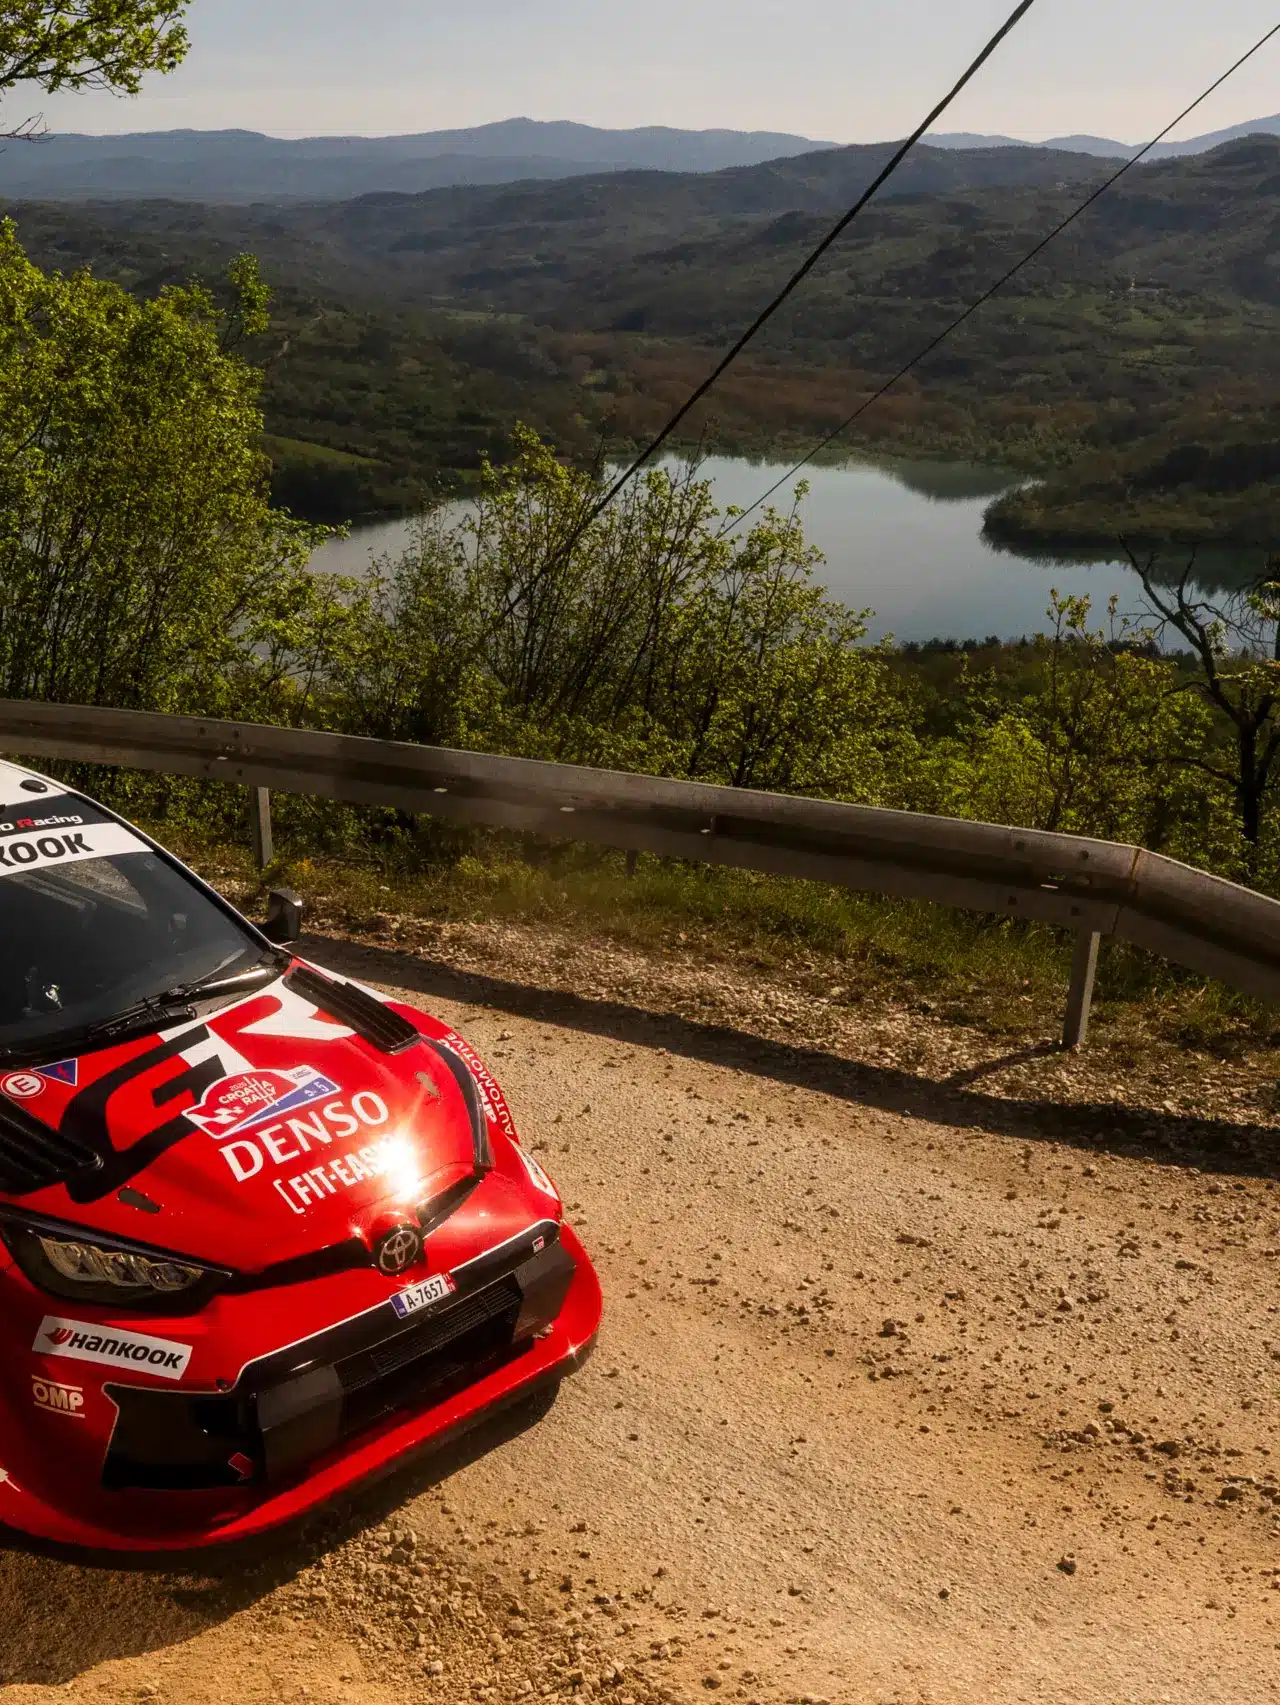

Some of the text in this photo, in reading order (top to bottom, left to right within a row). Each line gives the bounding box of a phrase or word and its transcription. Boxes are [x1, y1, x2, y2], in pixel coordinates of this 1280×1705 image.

[16, 815, 84, 829] Racing
[11, 1076, 37, 1094] E
[444, 1032, 514, 1136] AUTOMOTIVE
[219, 1091, 389, 1183] DENSO
[405, 1280, 444, 1309] A-7657
[32, 1382, 84, 1411] OMP
